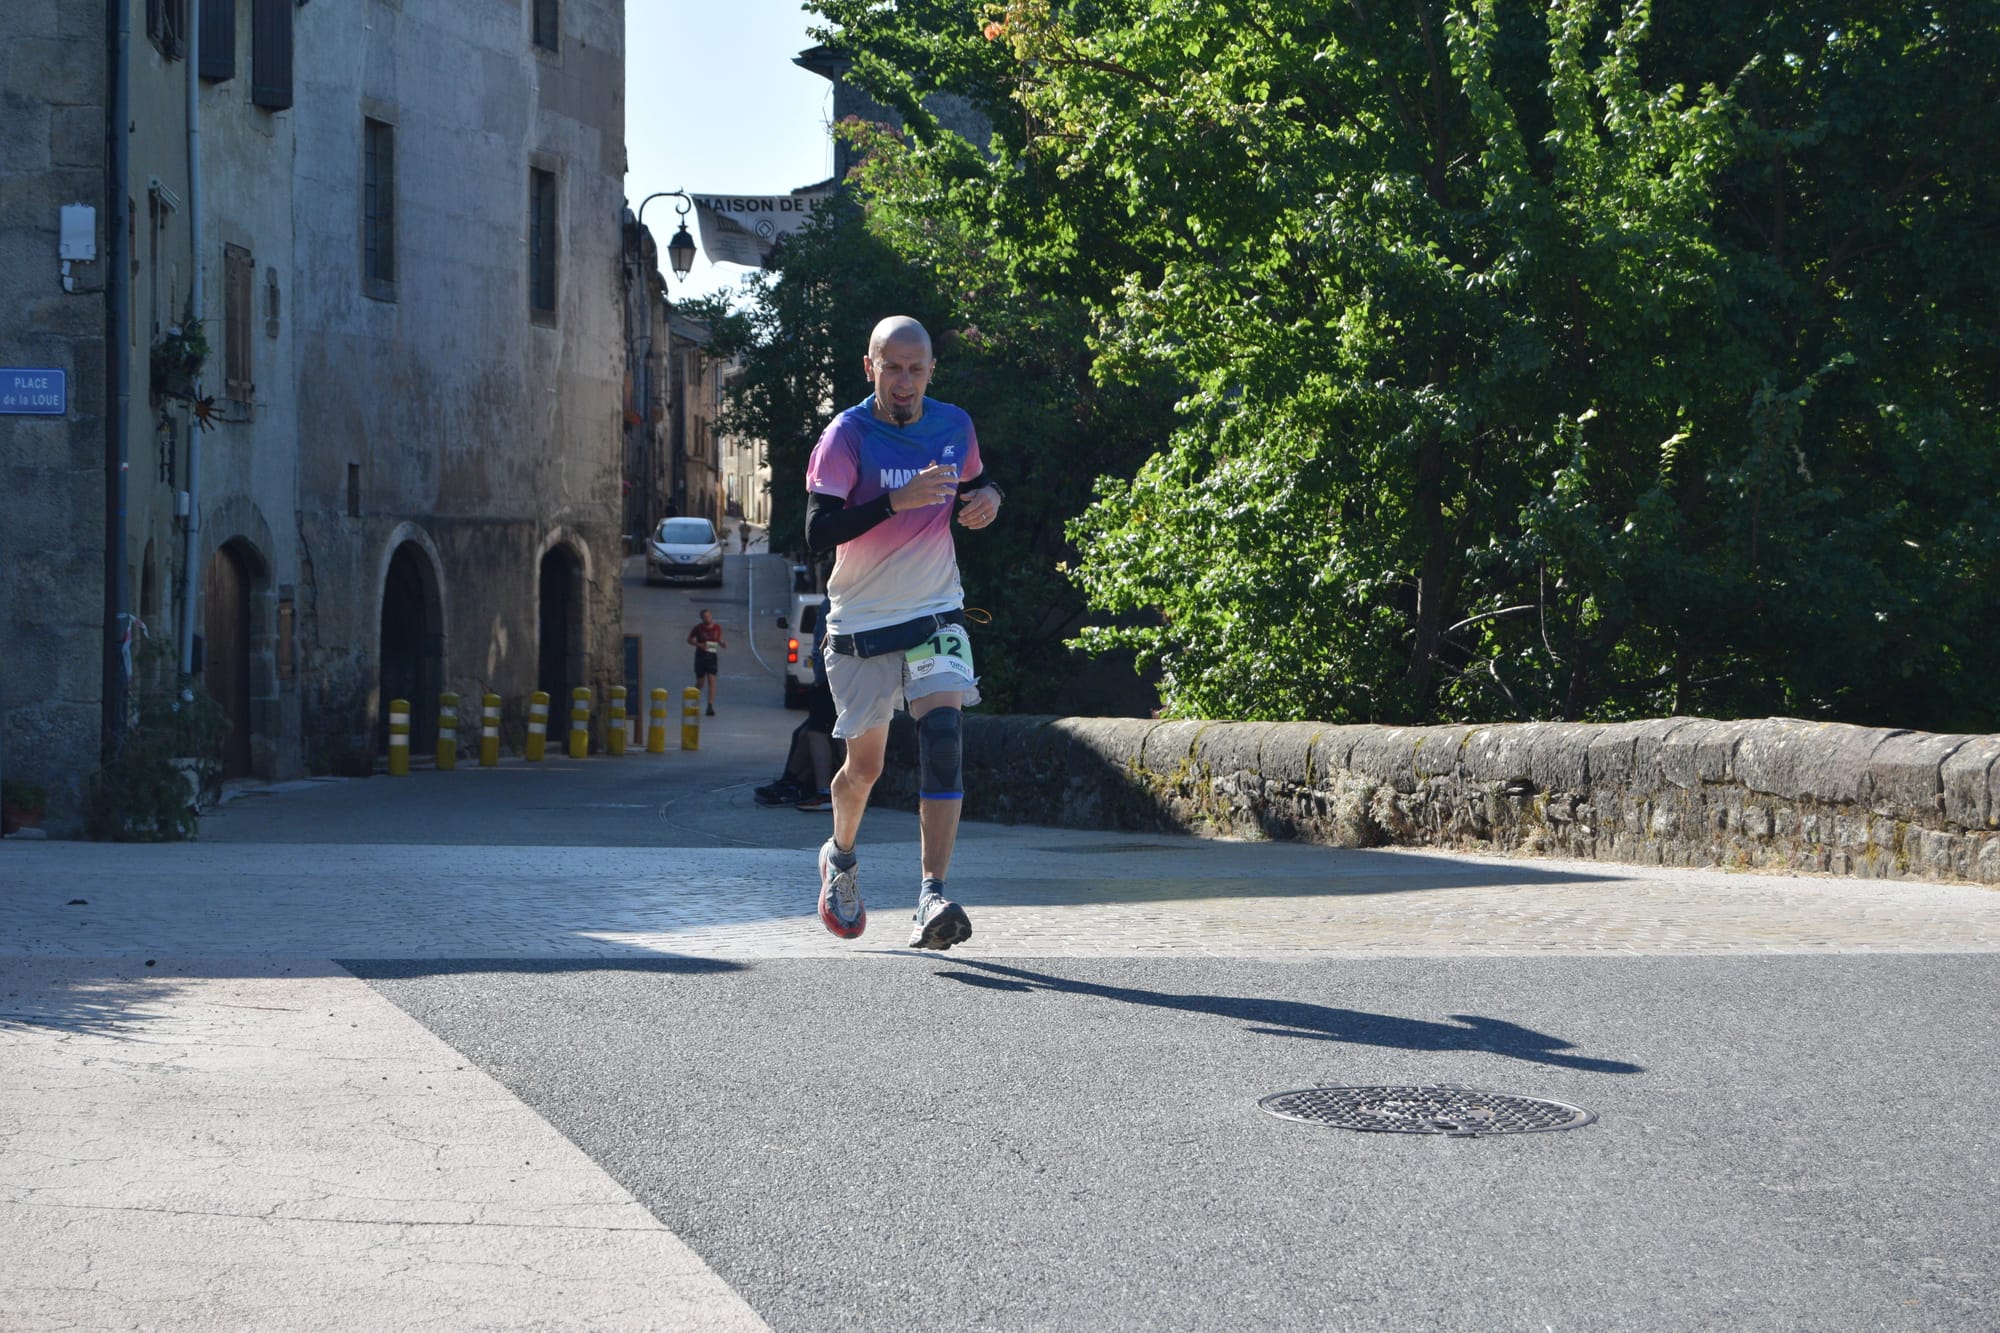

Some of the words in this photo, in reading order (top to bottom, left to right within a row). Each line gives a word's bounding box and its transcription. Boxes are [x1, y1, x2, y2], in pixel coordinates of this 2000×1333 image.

[697, 198, 774, 212] MAISON
[780, 199, 804, 212] DE
[15, 377, 49, 389] PLACE
[3, 394, 16, 405] de
[19, 394, 29, 405] la
[32, 394, 60, 406] LOUE
[927, 636, 962, 658] 12
